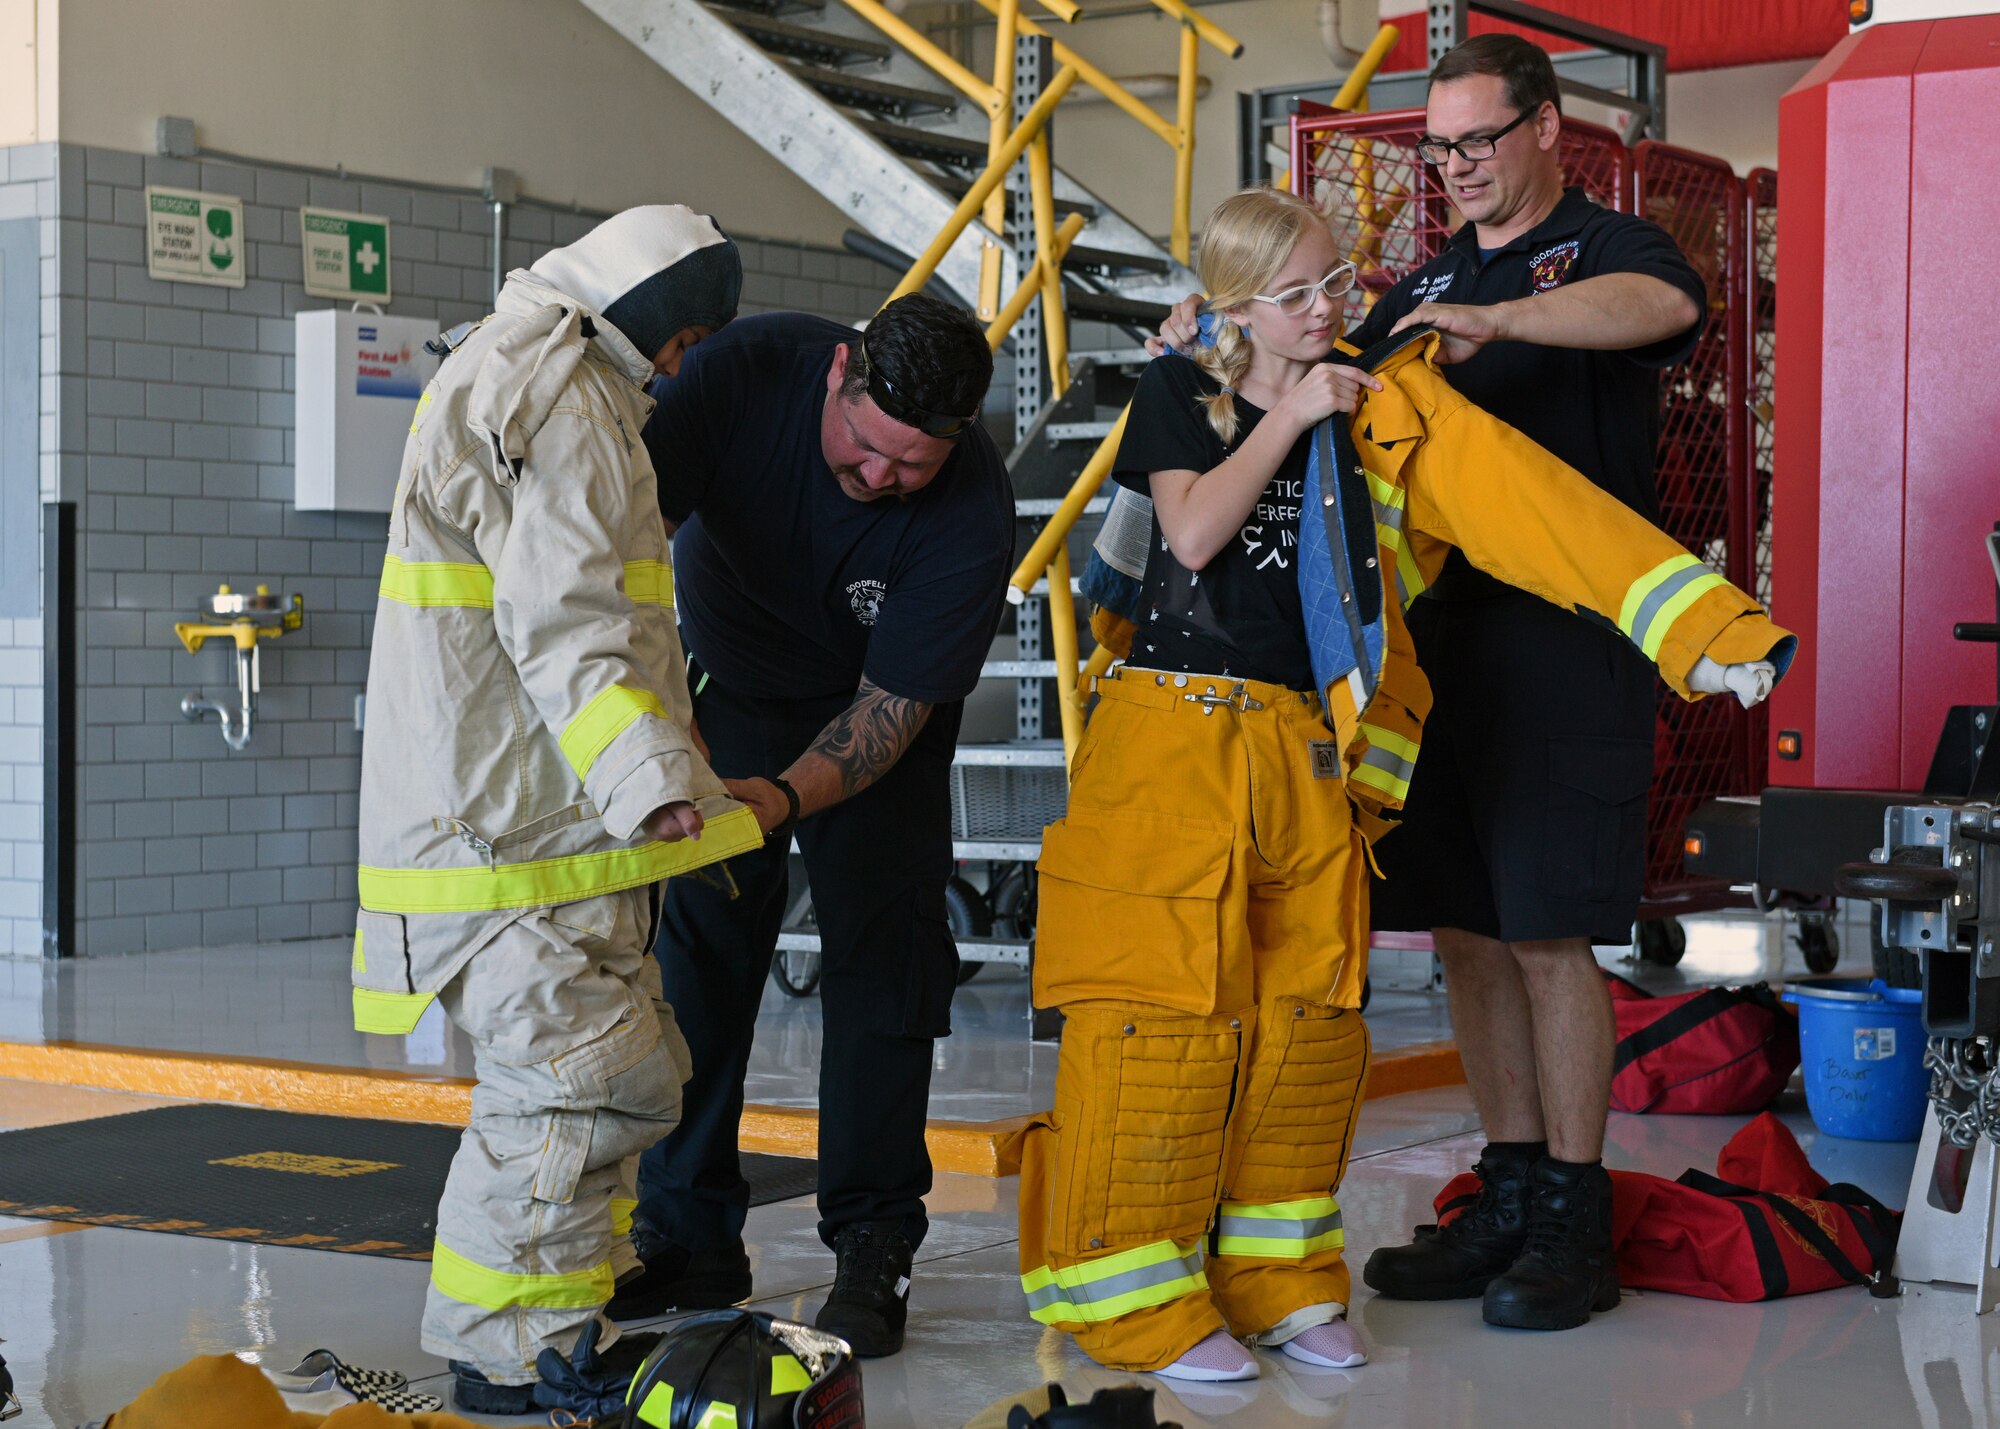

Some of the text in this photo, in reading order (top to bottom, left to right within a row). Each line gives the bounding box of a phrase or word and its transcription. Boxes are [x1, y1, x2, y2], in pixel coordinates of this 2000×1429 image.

[158, 222, 172, 234] EYE
[162, 236, 193, 250] STATION
[313, 247, 331, 258] FIRST
[315, 260, 342, 274] STATION
[358, 349, 399, 365] First Aid
[358, 364, 393, 378] Station
[845, 579, 887, 594] GOODFELL
